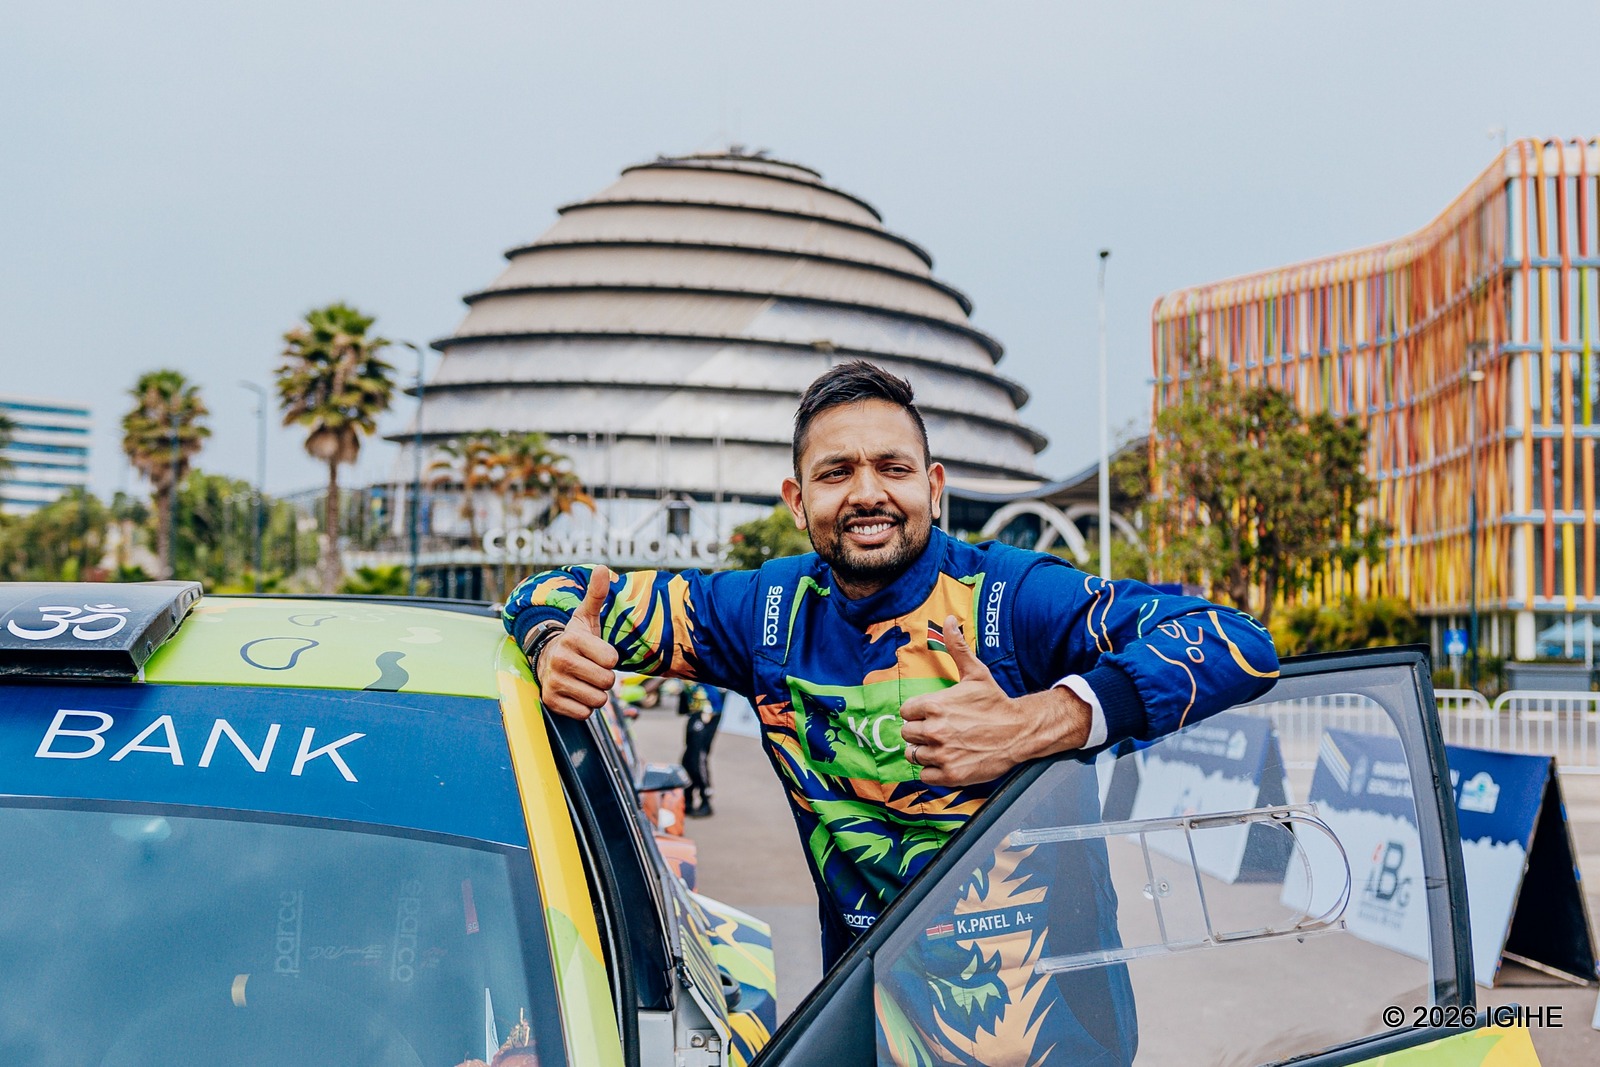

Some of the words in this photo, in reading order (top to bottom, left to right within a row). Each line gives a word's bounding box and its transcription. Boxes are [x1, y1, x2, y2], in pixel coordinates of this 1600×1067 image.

[483, 527, 694, 562] CONVENTION
[697, 535, 729, 562] C
[763, 585, 783, 646] sparco
[985, 581, 1007, 648] sparco
[34, 709, 366, 783] BANK
[847, 714, 908, 754] KC
[957, 914, 1010, 934] K.PATEL
[1016, 911, 1033, 925] A+
